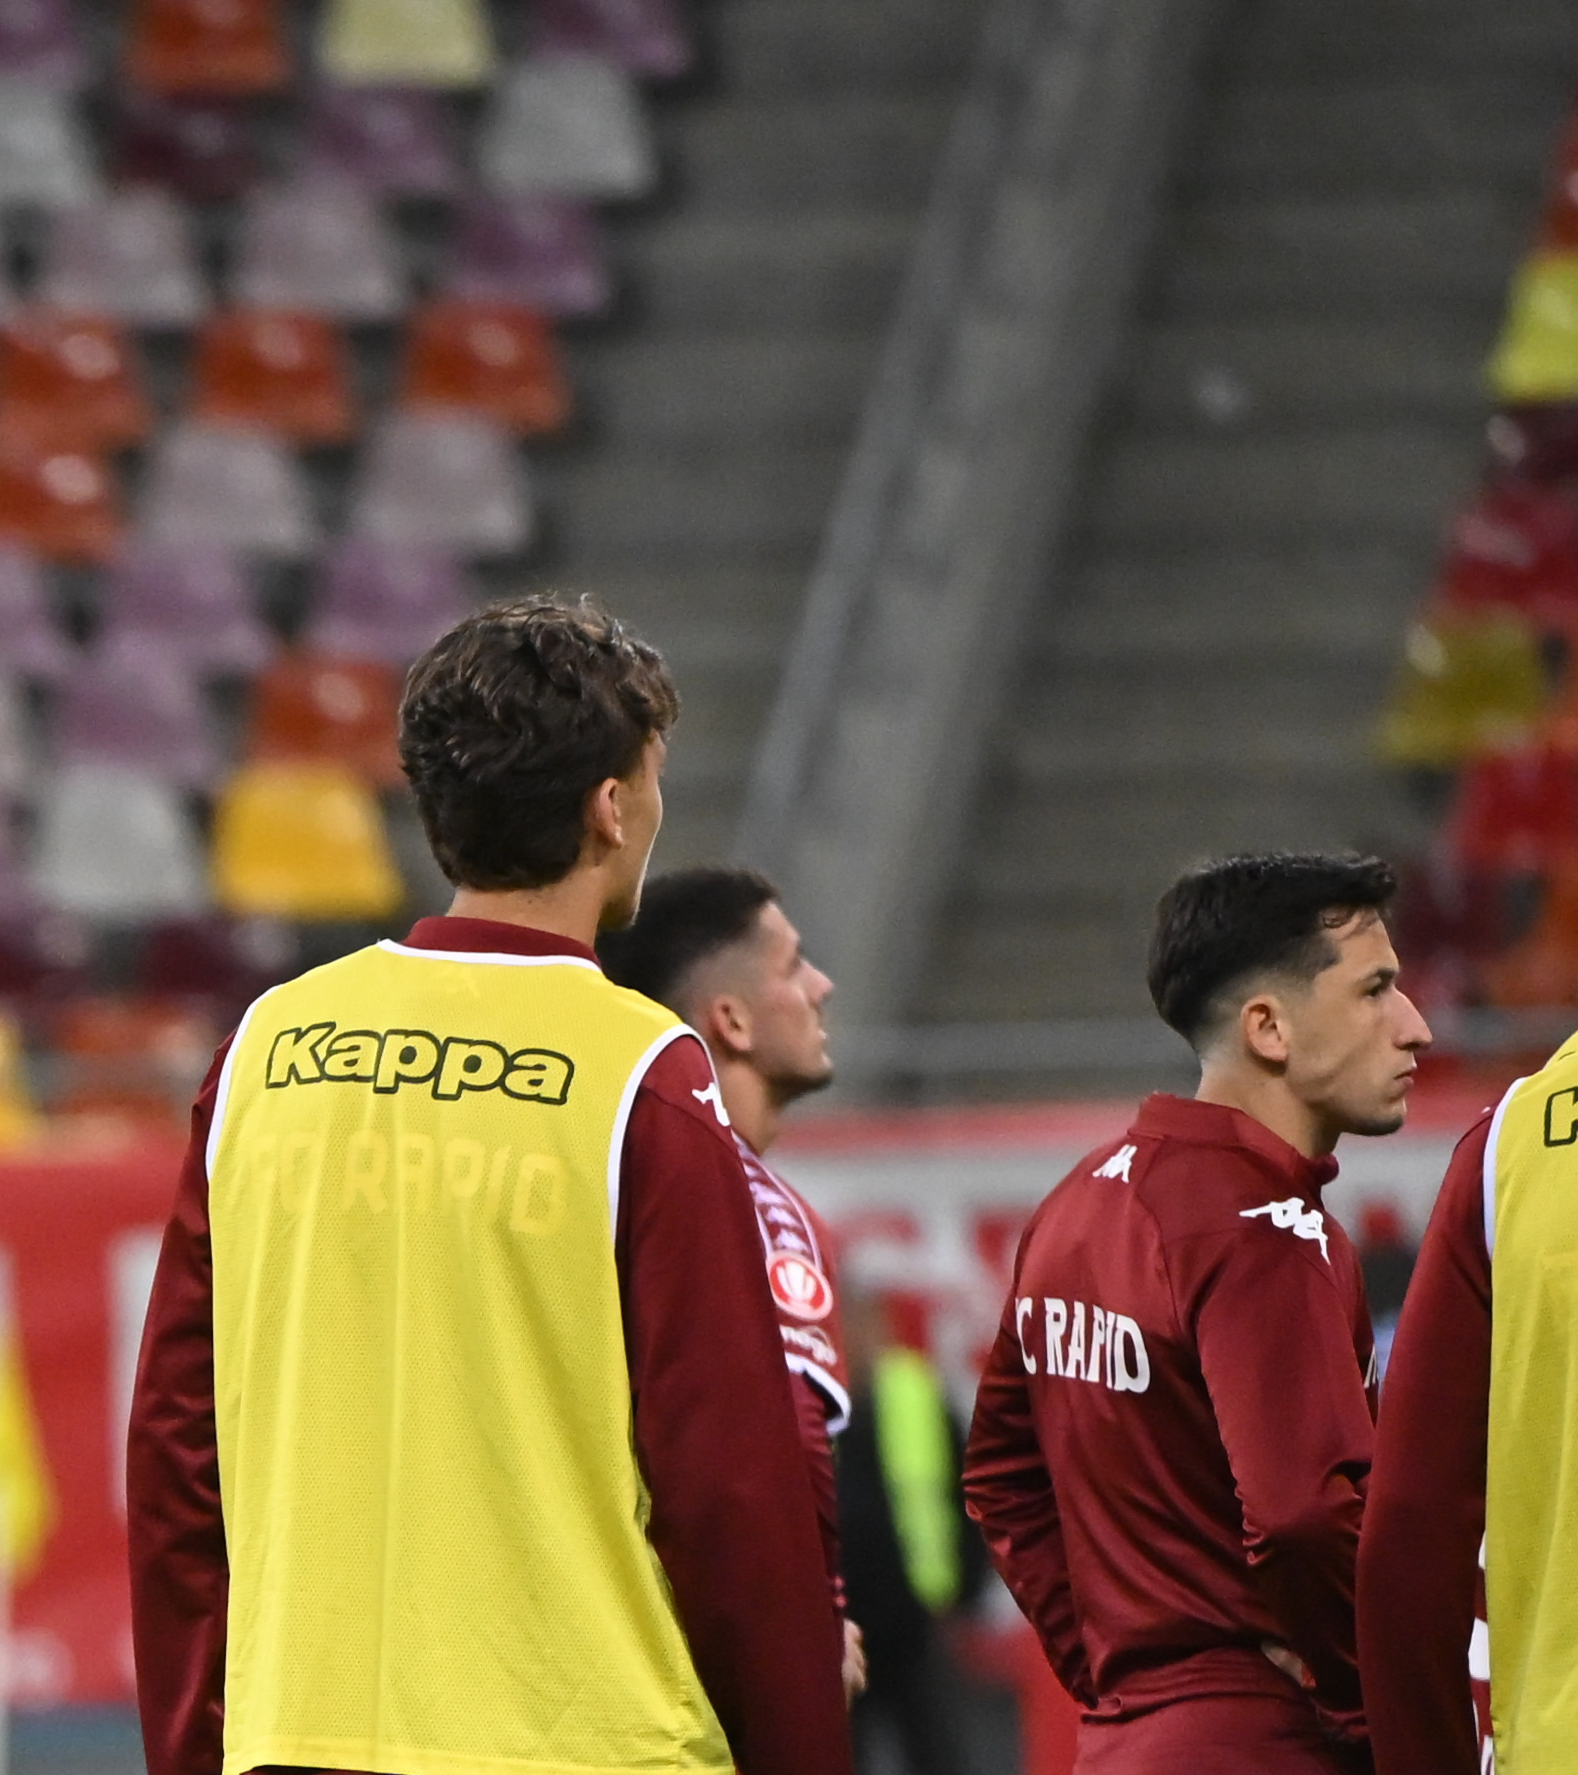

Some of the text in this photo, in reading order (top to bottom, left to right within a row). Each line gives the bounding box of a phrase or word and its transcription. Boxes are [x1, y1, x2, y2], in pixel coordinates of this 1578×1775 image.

[265, 1021, 575, 1106] Kappa
[1015, 1296, 1151, 1393] C RAPID
